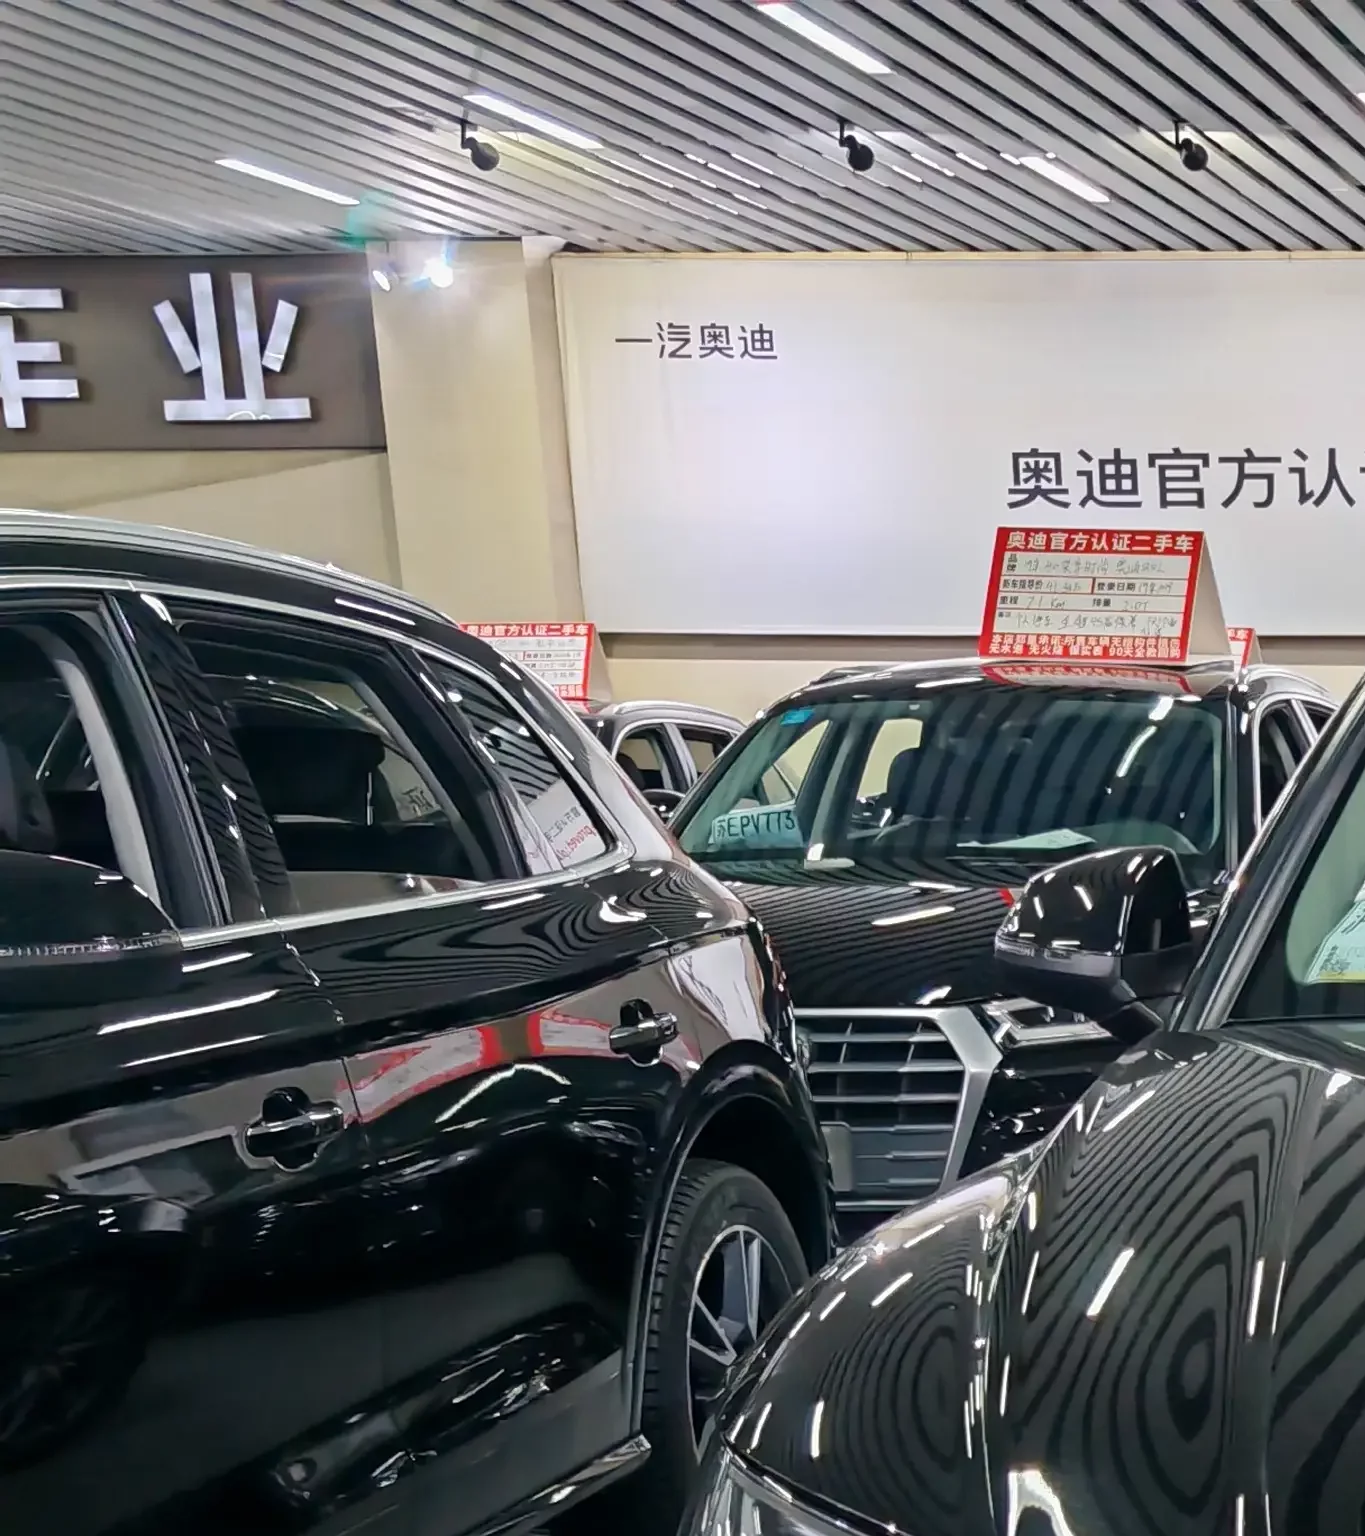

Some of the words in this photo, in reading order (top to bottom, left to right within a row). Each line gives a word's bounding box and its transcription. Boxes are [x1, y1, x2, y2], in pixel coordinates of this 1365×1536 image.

[614, 321, 778, 359] 一汽奥迪
[1006, 531, 1194, 552] 奥迪官方认证二手车
